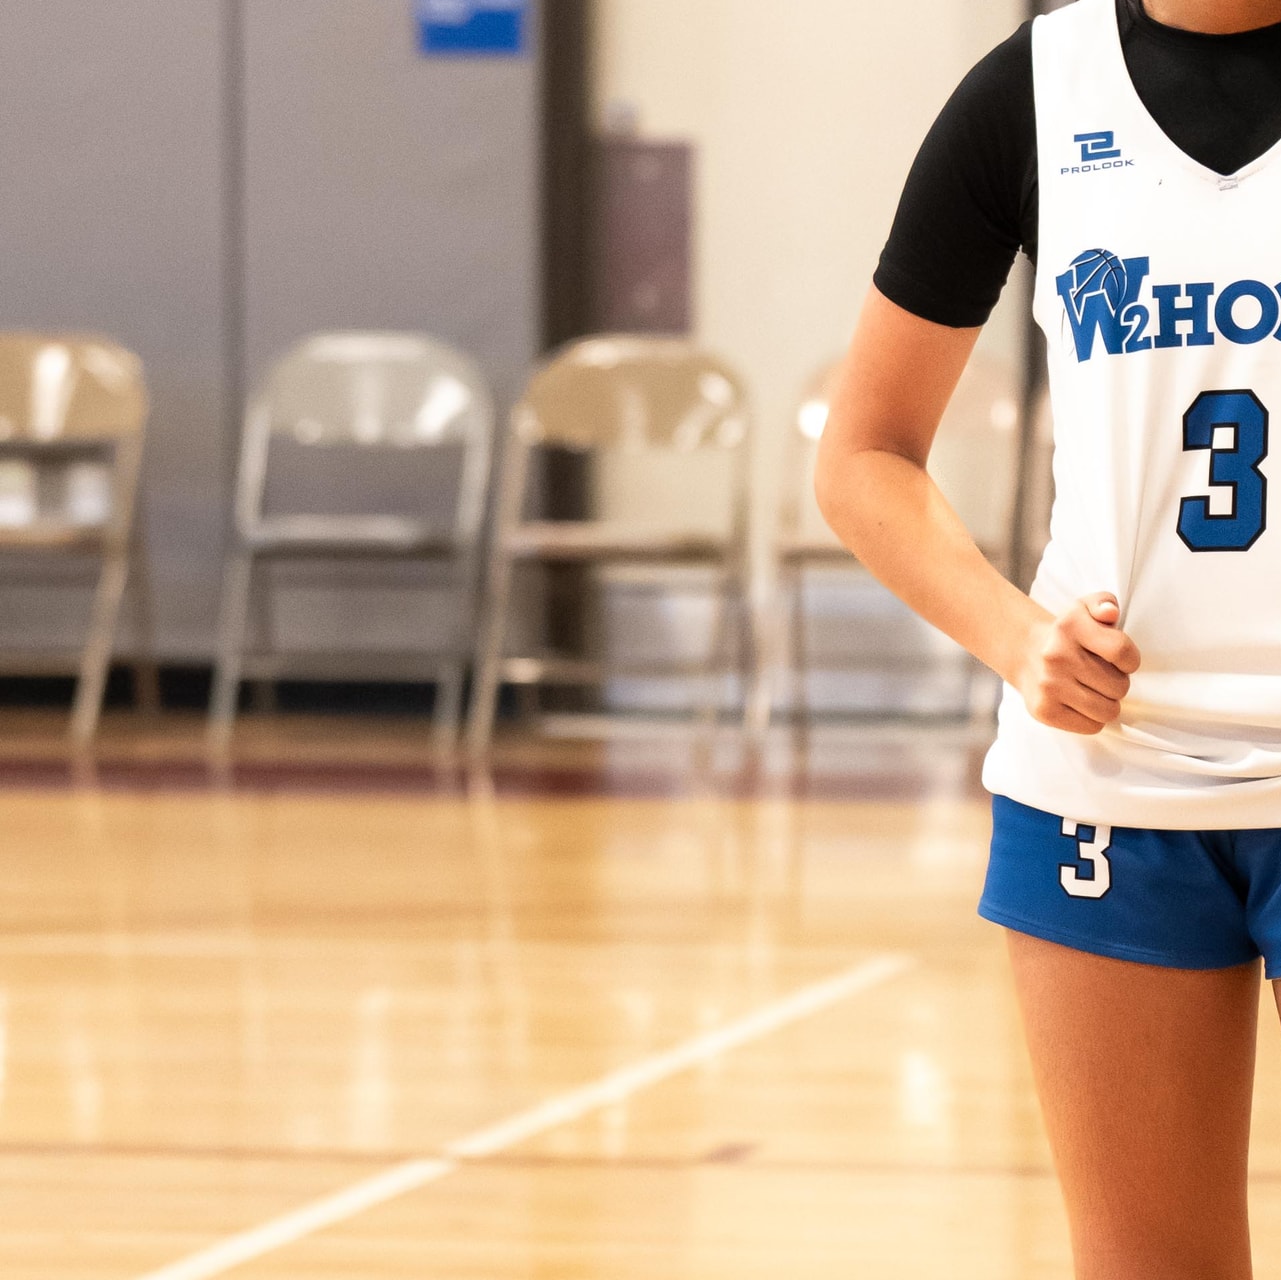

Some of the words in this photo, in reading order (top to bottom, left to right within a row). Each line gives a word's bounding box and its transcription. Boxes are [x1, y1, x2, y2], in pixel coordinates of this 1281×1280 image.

[1060, 158, 1136, 175] PROLOOK
[1176, 389, 1269, 552] 3
[1059, 816, 1112, 899] 3
